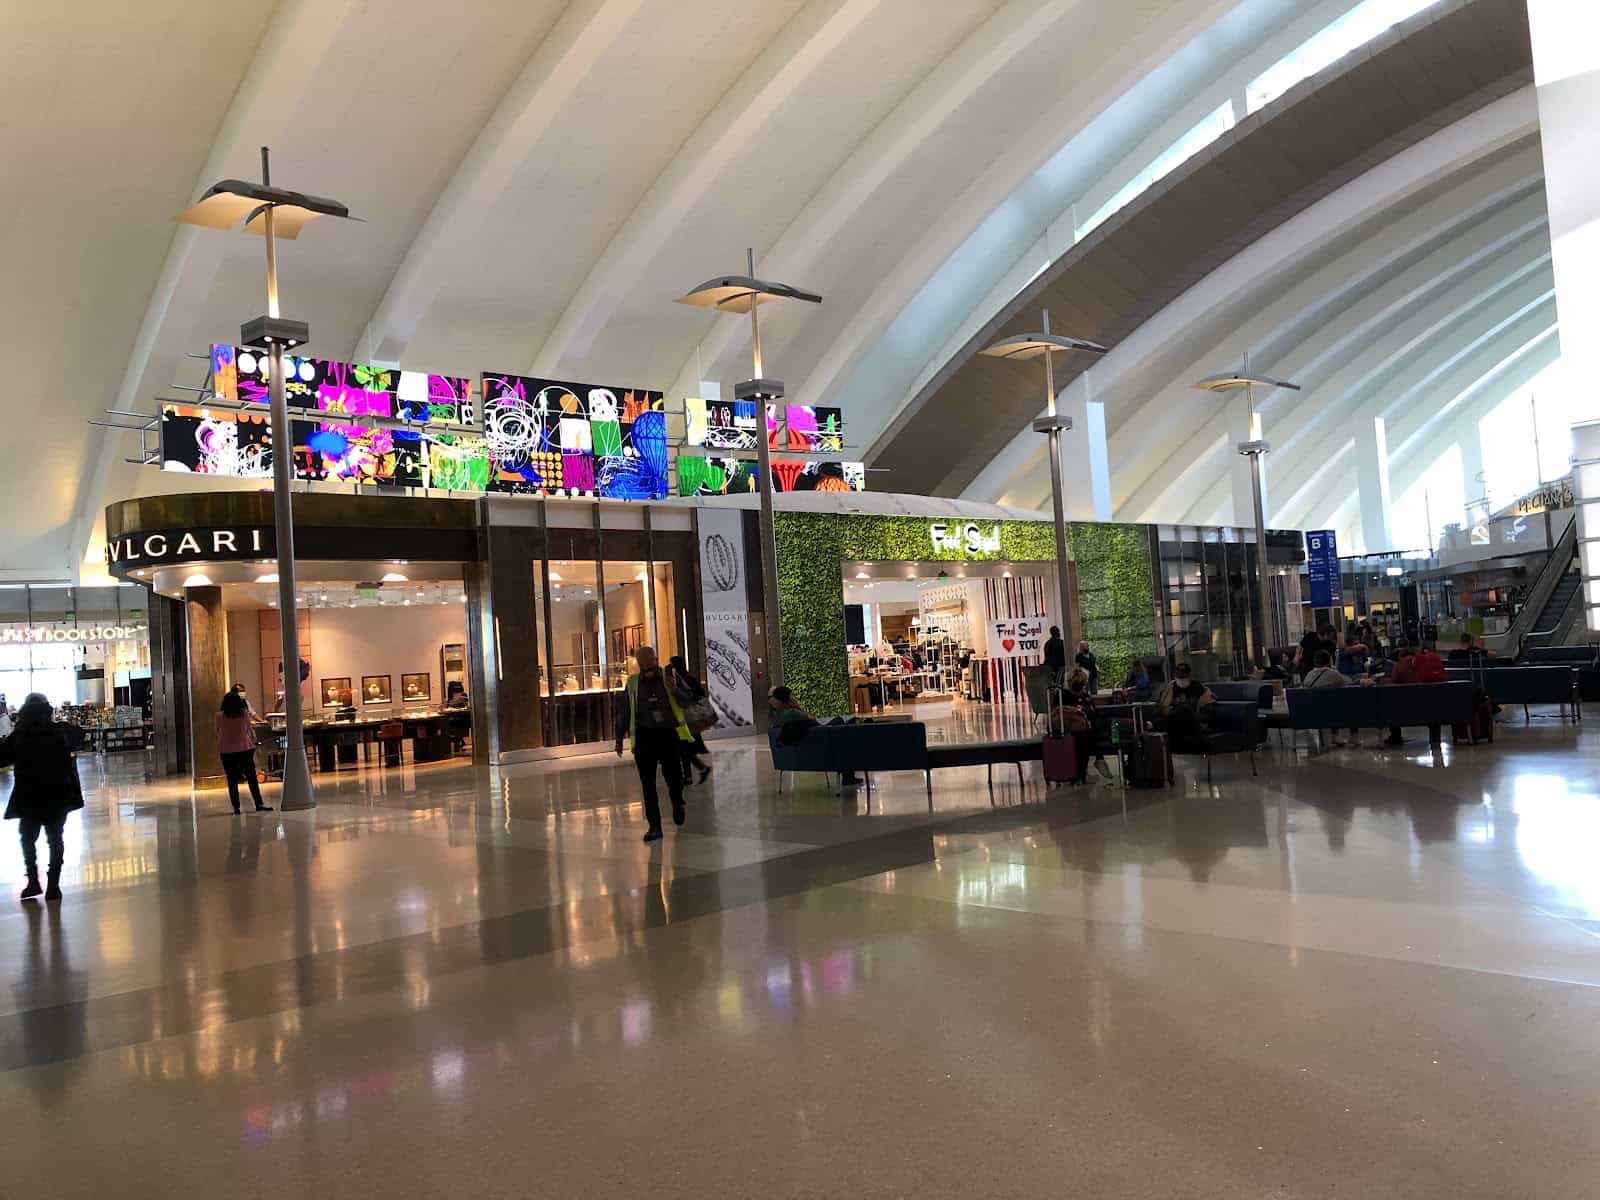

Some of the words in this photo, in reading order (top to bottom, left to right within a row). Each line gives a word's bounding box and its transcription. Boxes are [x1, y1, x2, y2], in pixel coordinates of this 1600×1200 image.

[1311, 537, 1321, 550] B
[995, 623, 1016, 639] Fred
[1018, 621, 1042, 637] Segal
[1018, 639, 1039, 650] YOU
